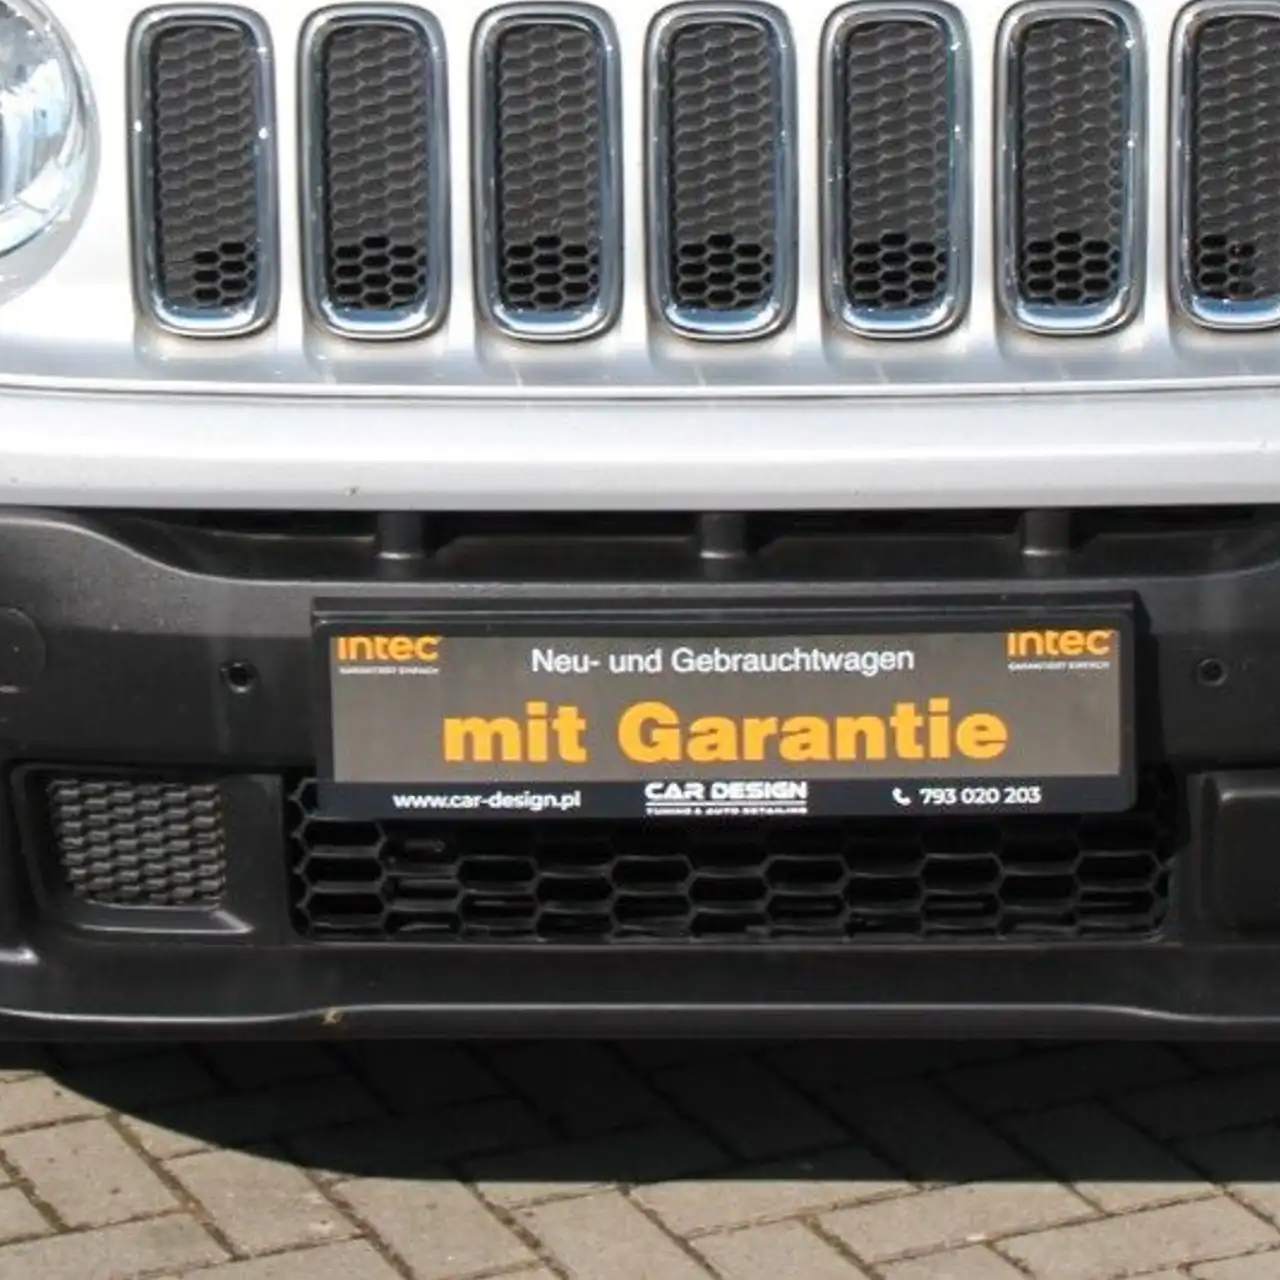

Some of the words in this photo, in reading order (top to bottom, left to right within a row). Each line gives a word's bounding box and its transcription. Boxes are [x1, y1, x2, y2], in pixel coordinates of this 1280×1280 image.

[337, 636, 440, 661] intec
[1007, 629, 1111, 657] intec
[531, 648, 600, 674] Neu-
[609, 649, 662, 673] und
[671, 647, 914, 677] Gebrauchtwagen
[443, 701, 587, 762] mit
[619, 698, 1009, 764] Garantie
[392, 790, 582, 812] www.car-design.pl
[644, 782, 705, 800] CAR
[711, 780, 808, 800] DESIGN
[920, 787, 957, 805] 793
[961, 787, 1000, 805] 020
[1003, 786, 1042, 804] 203
